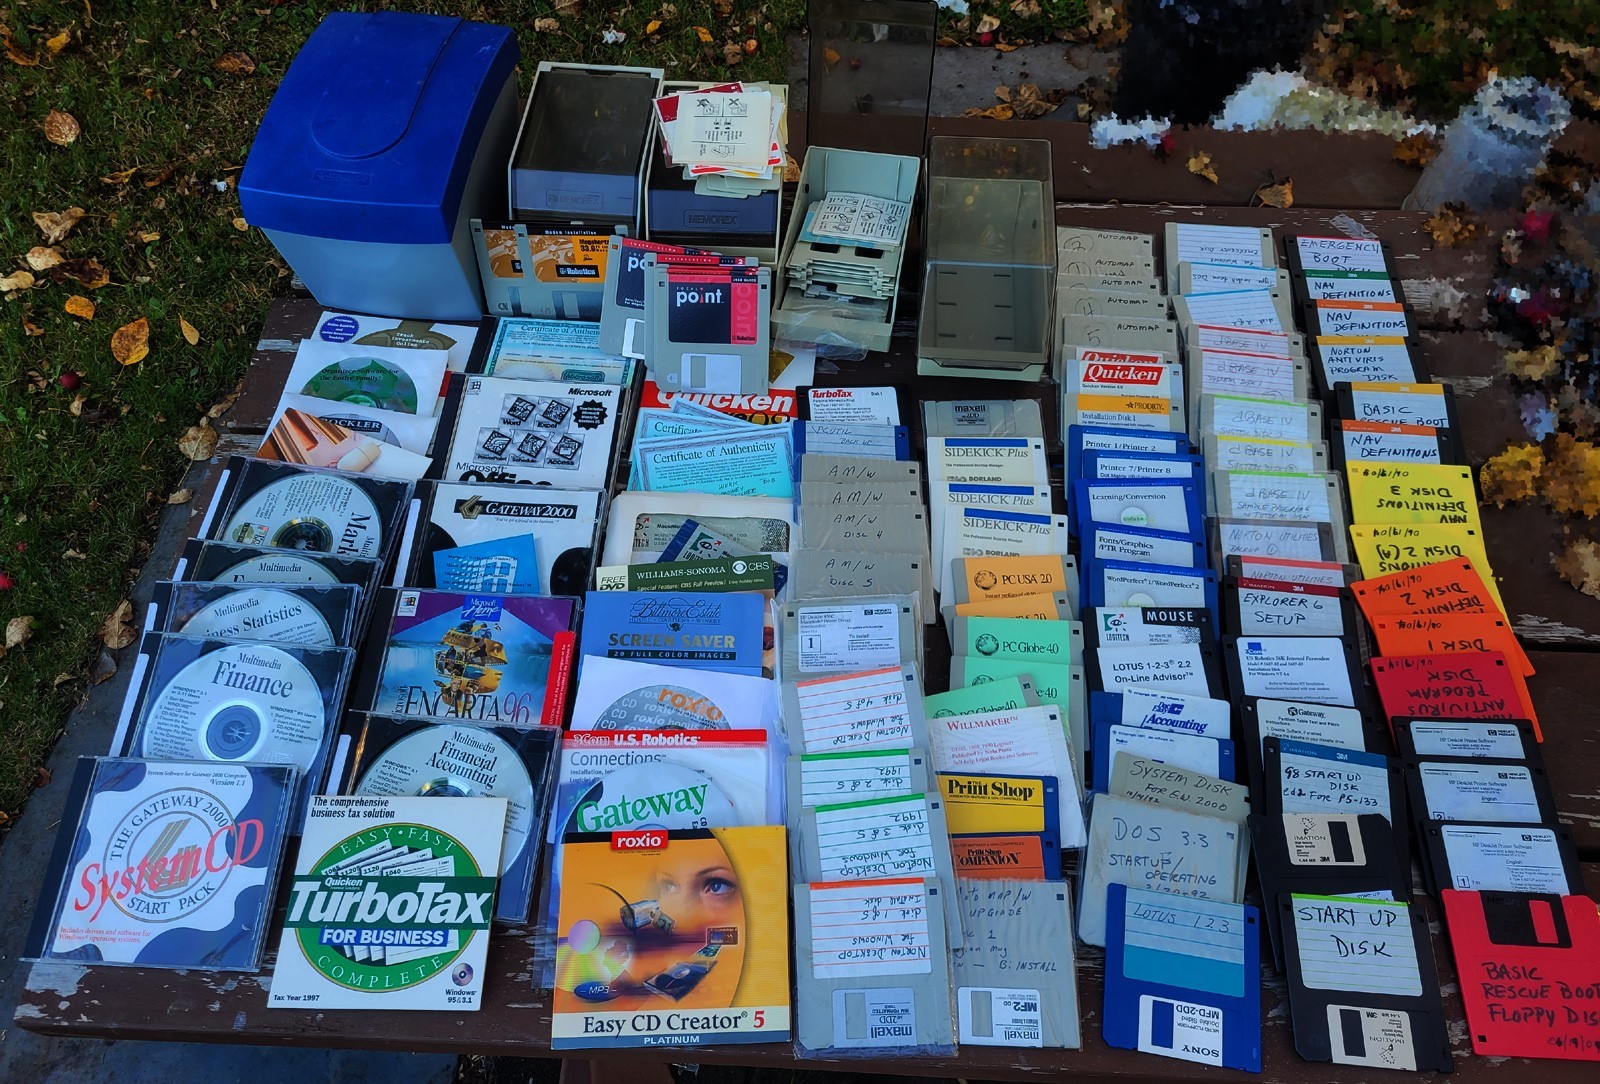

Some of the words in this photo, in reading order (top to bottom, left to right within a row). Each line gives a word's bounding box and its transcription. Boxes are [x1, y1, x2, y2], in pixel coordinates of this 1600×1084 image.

[688, 215, 737, 224] MEMOREX
[1301, 240, 1379, 254] EMERGENCY
[1095, 259, 1135, 267] AUTOMAP
[1307, 251, 1352, 266] BOOT
[1315, 282, 1335, 290] NAV
[676, 287, 722, 307] point
[1321, 290, 1391, 299] DEFINITIONS
[1326, 312, 1353, 322] NAV
[1334, 321, 1406, 332] DEFINITIONS
[1331, 347, 1371, 356] NORTON
[1087, 364, 1159, 381] Quicken
[1267, 366, 1280, 376] IV
[1329, 366, 1384, 375] PROGRAM
[568, 388, 612, 396] Microsoft
[812, 389, 852, 398] TurboTax
[954, 404, 986, 412] maxell
[1134, 402, 1163, 411] PRODIGY
[1362, 403, 1413, 416] BASIC
[1082, 413, 1116, 421] Installation
[1417, 418, 1448, 427] BOOT
[1351, 434, 1383, 446] NAV
[653, 450, 703, 464] Certificate
[706, 446, 716, 457] of
[719, 442, 776, 456] Authenticity
[945, 448, 1004, 457] SIDEKICK
[1007, 449, 1029, 457] Plus
[1114, 443, 1148, 451] 1/Printer
[1281, 447, 1294, 457] IV
[1361, 448, 1438, 459] DEFINITIONS
[456, 461, 504, 473] Microsoft
[1100, 464, 1126, 472] Printer
[949, 493, 1009, 504] SIDEKICK
[1012, 496, 1034, 506] Plus
[1297, 490, 1311, 500] IV
[1411, 488, 1453, 498] DISK
[1376, 499, 1468, 513] DEFINITIONS
[963, 518, 1025, 533] SIDEKICK
[1028, 525, 1051, 535] Plus
[877, 531, 883, 539] 4
[1229, 529, 1273, 541] NORTON
[1280, 532, 1318, 542] UTILITIES
[1098, 536, 1154, 549] Fonts/Graphics
[1120, 546, 1151, 557] Program
[1424, 545, 1464, 557] DISK
[258, 562, 302, 572] Multimedia
[636, 566, 726, 580] WILLIAMS-SONOMA
[748, 562, 770, 571] CBS
[600, 576, 626, 584] FREE
[600, 582, 625, 590] DVD
[863, 578, 873, 588] 5
[1002, 575, 1016, 585] PC
[1018, 574, 1038, 584] USA
[1422, 582, 1469, 599] DISK
[471, 598, 496, 607] Microsoft
[1243, 593, 1308, 609] EXPLORER
[1313, 600, 1323, 610] 6
[242, 605, 302, 633] Statistics
[1146, 611, 1194, 622] MOUSE
[1255, 611, 1306, 626] SETUP
[608, 634, 675, 647] SCREEN
[681, 635, 735, 649] SAVER
[1002, 641, 1017, 652] PC
[1018, 642, 1044, 653] Globe
[1442, 638, 1491, 652] DISK
[237, 652, 282, 671] Multimedia
[1112, 662, 1144, 671] LOTUS
[211, 660, 294, 698] Finance
[1427, 668, 1482, 682] DISK
[1407, 683, 1490, 699] PROGRAM
[405, 685, 500, 721] ENCARTA
[504, 692, 530, 723] 96
[658, 688, 722, 721] roxio
[1409, 699, 1505, 716] ANTIVIRUS
[1299, 709, 1325, 718] Gateway
[1145, 714, 1208, 734] Accounting
[451, 731, 496, 754] Multimedia
[614, 734, 639, 745] U.S.
[642, 734, 698, 746] Robotics
[439, 740, 498, 772] Financial
[570, 751, 661, 767] Connections
[425, 752, 498, 790] Accounting
[1304, 770, 1342, 780] START
[1130, 761, 1188, 785] SYSTEM
[1193, 775, 1233, 796] DISK
[948, 779, 988, 796] Print
[991, 781, 1033, 801] Shop
[1330, 782, 1359, 792] DISK
[313, 797, 328, 807] The
[329, 798, 389, 808] comprehensive
[577, 784, 708, 833] Gateway
[1195, 796, 1228, 812] 2000
[311, 807, 346, 819] business
[347, 808, 361, 819] tax
[363, 809, 395, 819] solution
[110, 830, 133, 861] THE
[131, 794, 203, 827] GATEWAY
[202, 802, 229, 828] 2000
[1113, 817, 1162, 842] DOS
[1181, 831, 1209, 848] 3.3
[340, 827, 394, 854] EASY
[407, 827, 457, 852] FAST
[617, 835, 661, 848] roxio
[324, 877, 364, 887] Quicken
[1145, 869, 1217, 885] OPERATING
[127, 896, 170, 915] START
[179, 881, 216, 911] PACK
[288, 881, 492, 924] TurboTax
[1134, 904, 1176, 924] LOTUS
[1298, 905, 1359, 927] START
[1369, 910, 1397, 927] UP
[322, 929, 356, 944] FOR
[360, 930, 445, 945] BUSINESS
[891, 947, 926, 957] NORTON
[1330, 935, 1392, 958] DISK
[318, 955, 443, 988] COMPLETE
[1481, 961, 1543, 981] BASIC
[445, 988, 475, 996] Windows
[588, 985, 609, 995] MP3
[1481, 983, 1551, 1000] RESCUE
[302, 994, 320, 1002] 1997
[1176, 1004, 1220, 1020] MFD-2DD
[1487, 1003, 1555, 1028] FLOPPY
[583, 1016, 627, 1039] Easy
[631, 1015, 661, 1032] CD
[753, 1010, 765, 1029] 5
[871, 1026, 912, 1039] maxell
[1004, 1030, 1040, 1040] maxell
[644, 1036, 700, 1045] PLATINUM
[1182, 1045, 1220, 1058] SONY
